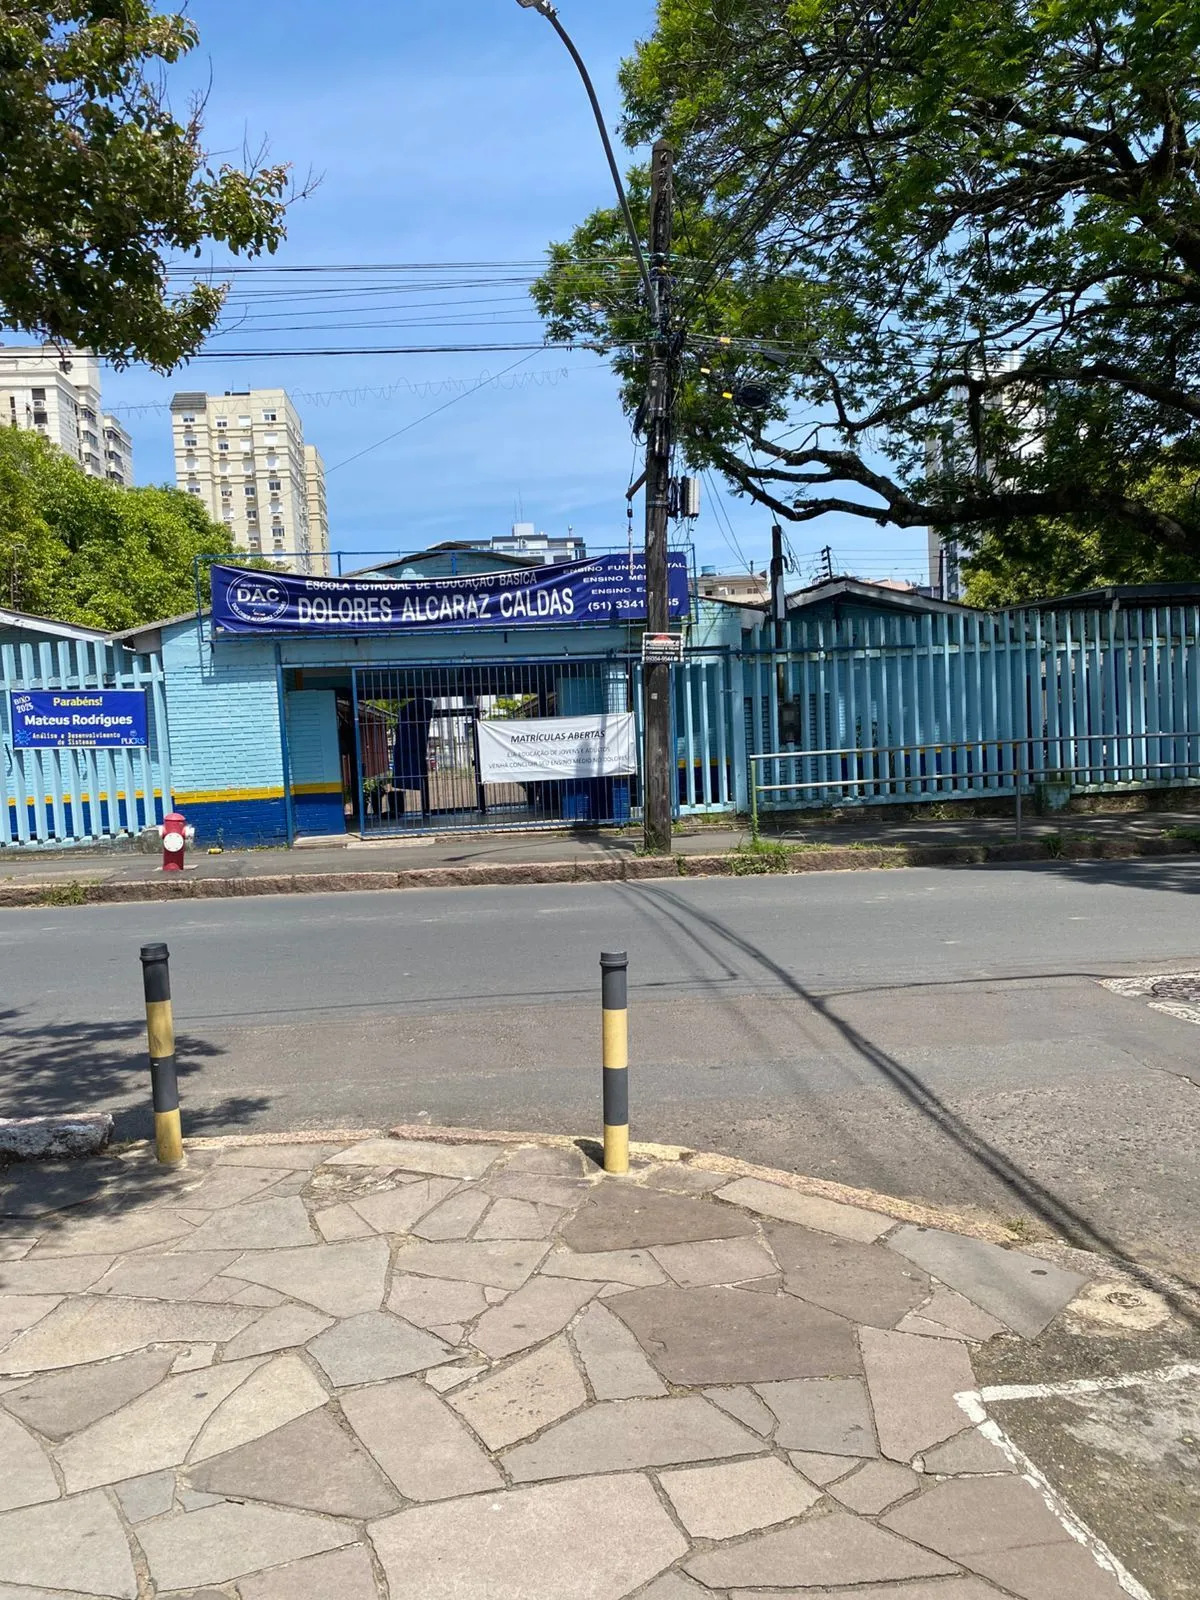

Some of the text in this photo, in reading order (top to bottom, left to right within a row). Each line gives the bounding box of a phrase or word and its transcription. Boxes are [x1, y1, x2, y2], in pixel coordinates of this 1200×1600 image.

[583, 575, 623, 583] ENSINO
[305, 580, 351, 591] ESCOLA
[591, 587, 631, 595] ENSINO
[236, 588, 280, 602] DAC
[298, 587, 574, 624] DOLORES ALCARAZ CALDAS
[588, 601, 612, 612] (51)
[53, 696, 103, 707] Parabéns!
[16, 702, 34, 714] 2025
[24, 714, 133, 727] Mateus Rodrigues
[510, 730, 605, 744] MATRÍCULAS ABERTAS
